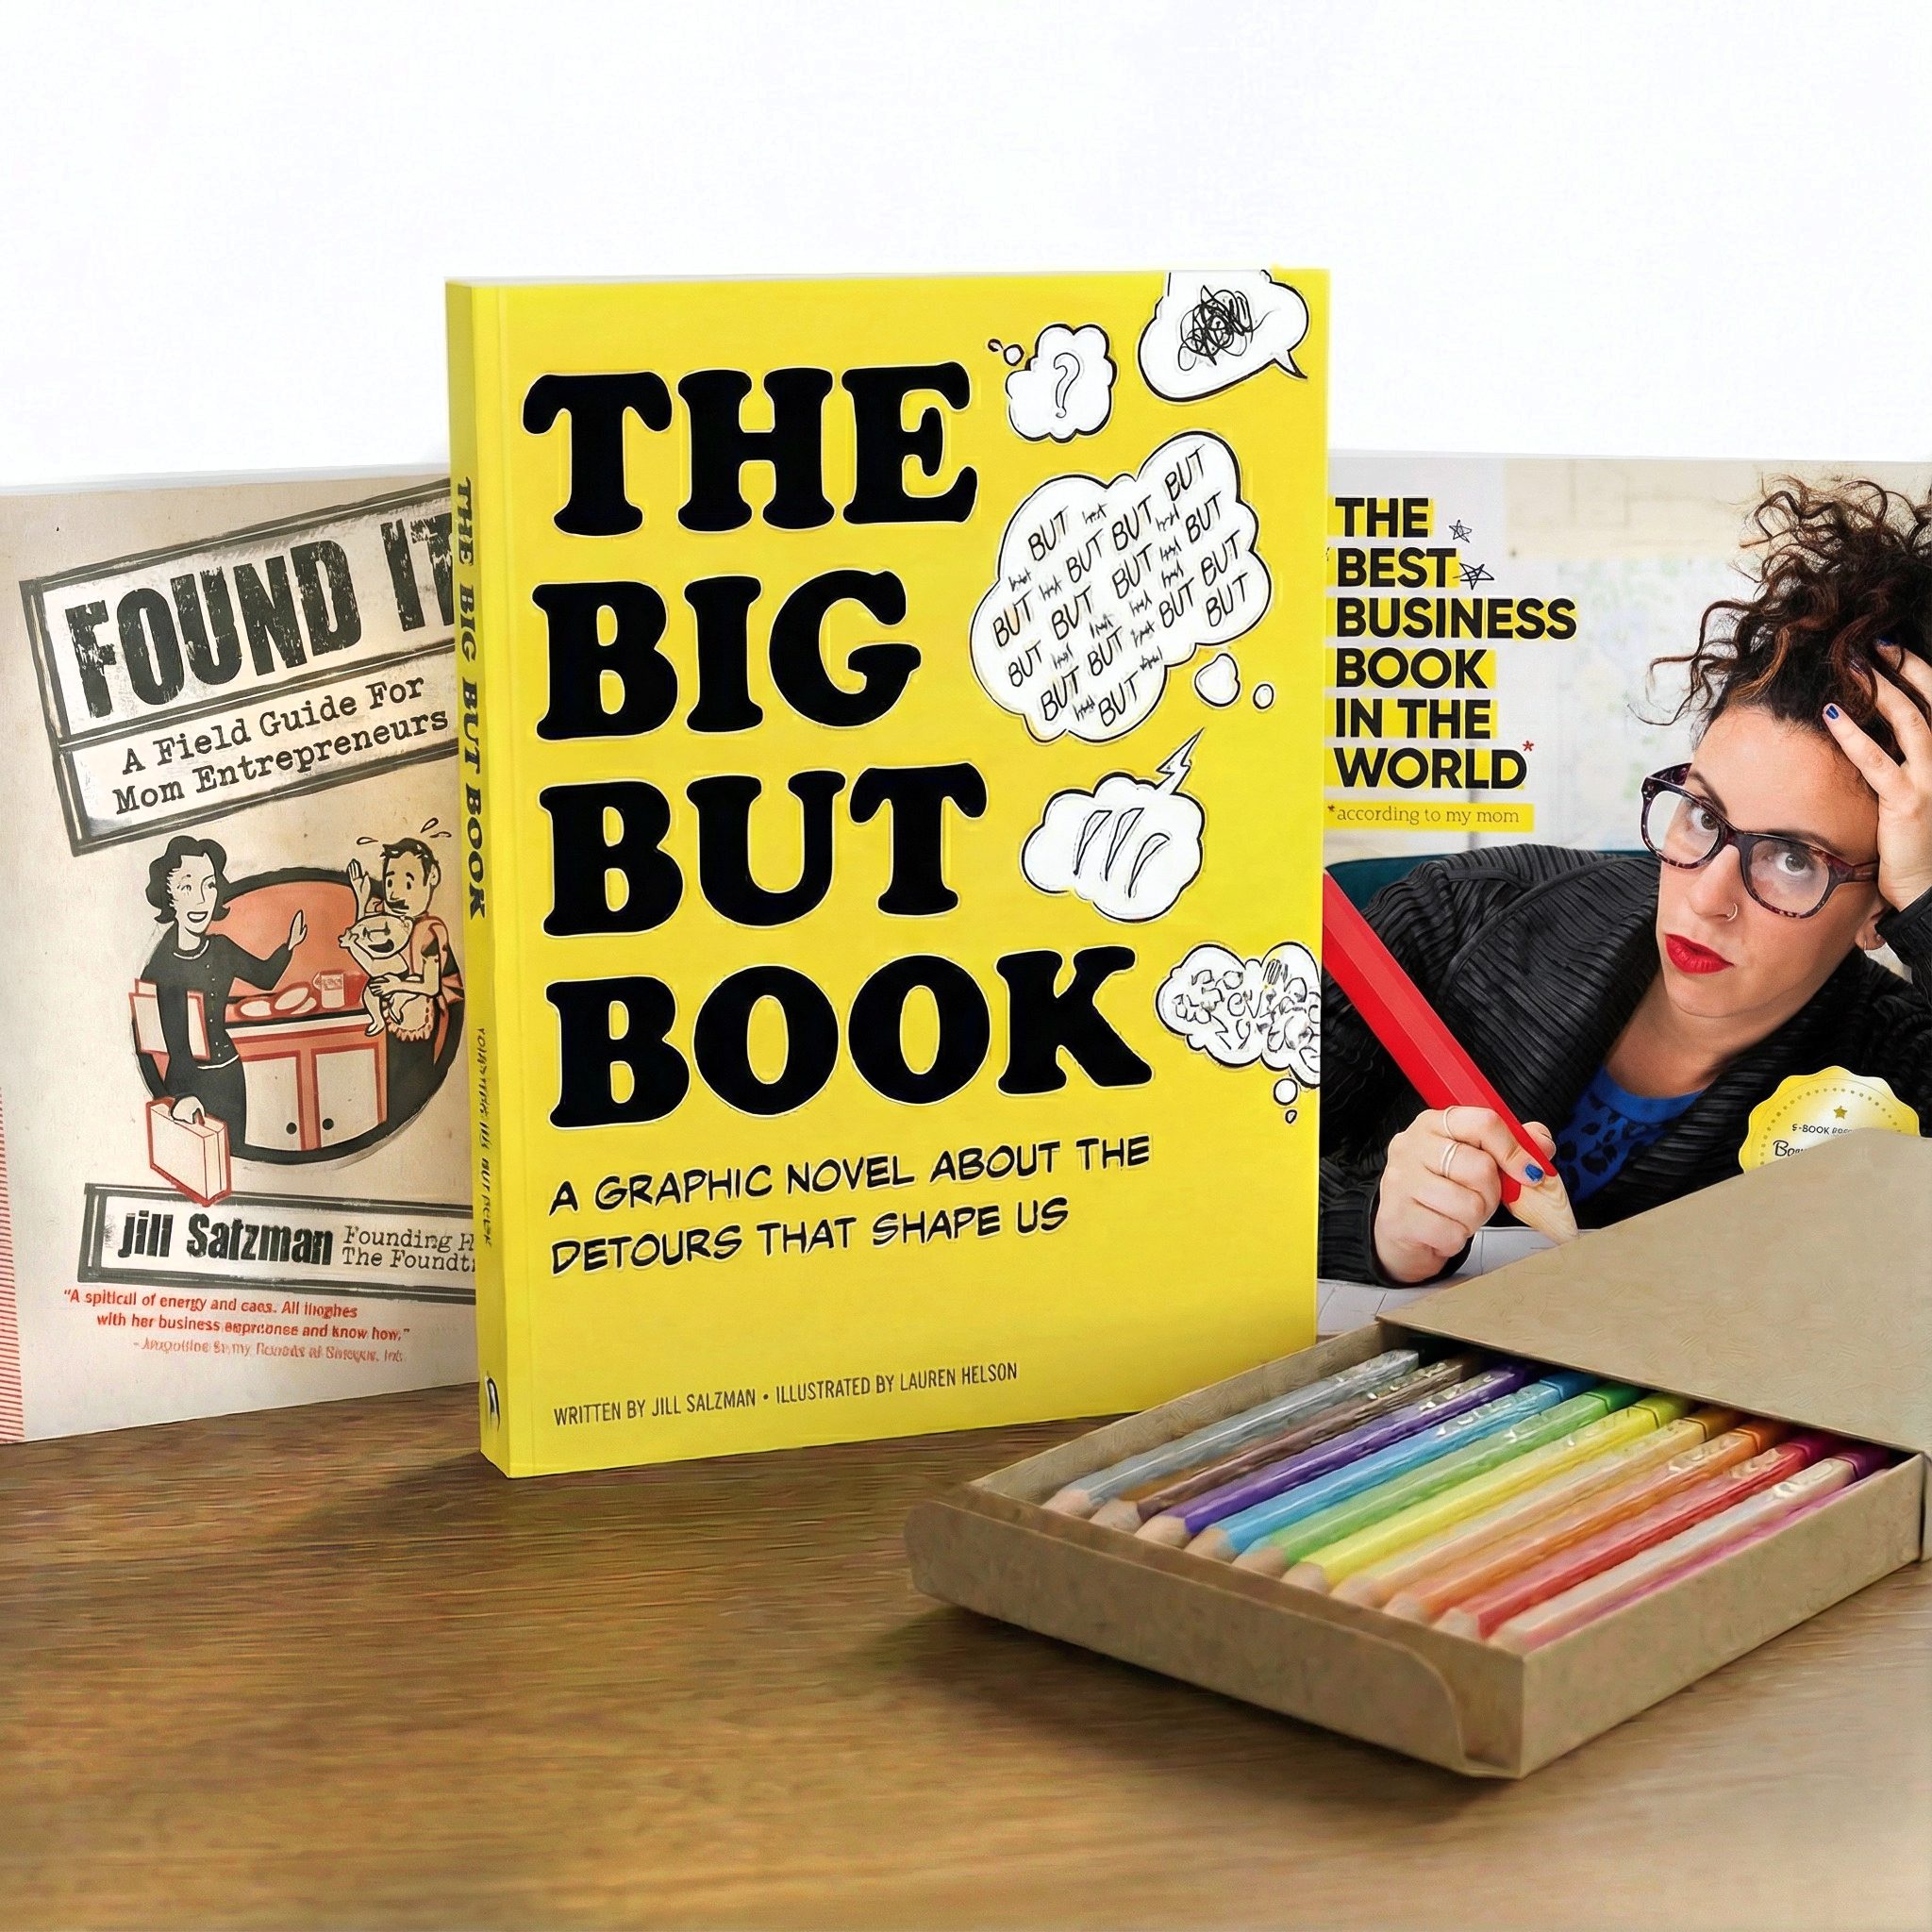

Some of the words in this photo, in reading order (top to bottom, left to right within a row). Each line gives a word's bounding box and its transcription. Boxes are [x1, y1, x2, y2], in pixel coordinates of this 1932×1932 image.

[523, 362, 977, 536] THE
[458, 477, 474, 566] THE
[992, 590, 1033, 647] BUT
[1066, 528, 1103, 583] BUT
[1111, 494, 1152, 551] BUT
[1164, 443, 1205, 502] BUT
[1027, 506, 1069, 561] BUT
[1335, 497, 1428, 538] THE
[1008, 640, 1041, 687] BUT
[1051, 586, 1092, 641] BUT
[1111, 542, 1153, 599] BUT
[1185, 491, 1222, 543] BUT
[1338, 547, 1457, 588] BEST
[65, 540, 361, 718] FOUND
[460, 584, 475, 661] BIG
[532, 570, 921, 741] BIG
[1041, 666, 1079, 722] BUT
[1088, 626, 1123, 676] BUT
[1158, 577, 1195, 628] BUT
[1201, 529, 1241, 586] BUT
[1098, 670, 1138, 726] BUT
[1206, 572, 1248, 627] BUT
[1337, 597, 1576, 640] BUSINESS
[1337, 647, 1488, 689] BOOK
[123, 748, 145, 774] A
[153, 718, 251, 766] Field
[258, 695, 357, 737] Guide
[365, 676, 424, 708] For
[462, 677, 480, 774] BUT
[1336, 698, 1382, 738] IN
[1397, 699, 1491, 739] THE
[112, 785, 185, 815] Mom
[192, 710, 448, 793] Entrepreneurs
[466, 783, 485, 919] BOOK
[540, 763, 987, 936] BUT
[1424, 809, 1441, 822] to
[1447, 811, 1471, 825] my
[1477, 812, 1519, 823] mom
[546, 946, 1152, 1127] BOOK
[549, 1181, 577, 1215] A
[595, 1165, 772, 1209] GRAPHIC
[788, 1156, 914, 1193] NOVEL
[930, 1141, 1060, 1182] ABOUT
[1076, 1136, 1149, 1170] THE
[342, 1225, 453, 1255] Founding
[342, 1247, 382, 1266] The
[552, 1225, 741, 1274] DETOURS
[757, 1217, 857, 1256] THAT
[873, 1206, 1000, 1245] SHAPE
[1018, 1197, 1068, 1233] US
[97, 1312, 125, 1325] with
[132, 1314, 154, 1327] her
[158, 1315, 220, 1331] business
[303, 1324, 327, 1337] and
[332, 1325, 367, 1339] know
[142, 1293, 156, 1306] of
[210, 1298, 237, 1310] and
[281, 1301, 299, 1314] All
[554, 1402, 621, 1425] WRITTEN
[627, 1400, 645, 1419] BY
[652, 1396, 681, 1416] JILL
[687, 1389, 755, 1412] SALZMAN
[776, 1377, 870, 1404] ILLUSTRATED
[876, 1375, 894, 1393] BY
[901, 1369, 956, 1391] LAUREN
[962, 1362, 1016, 1385] HELSON
